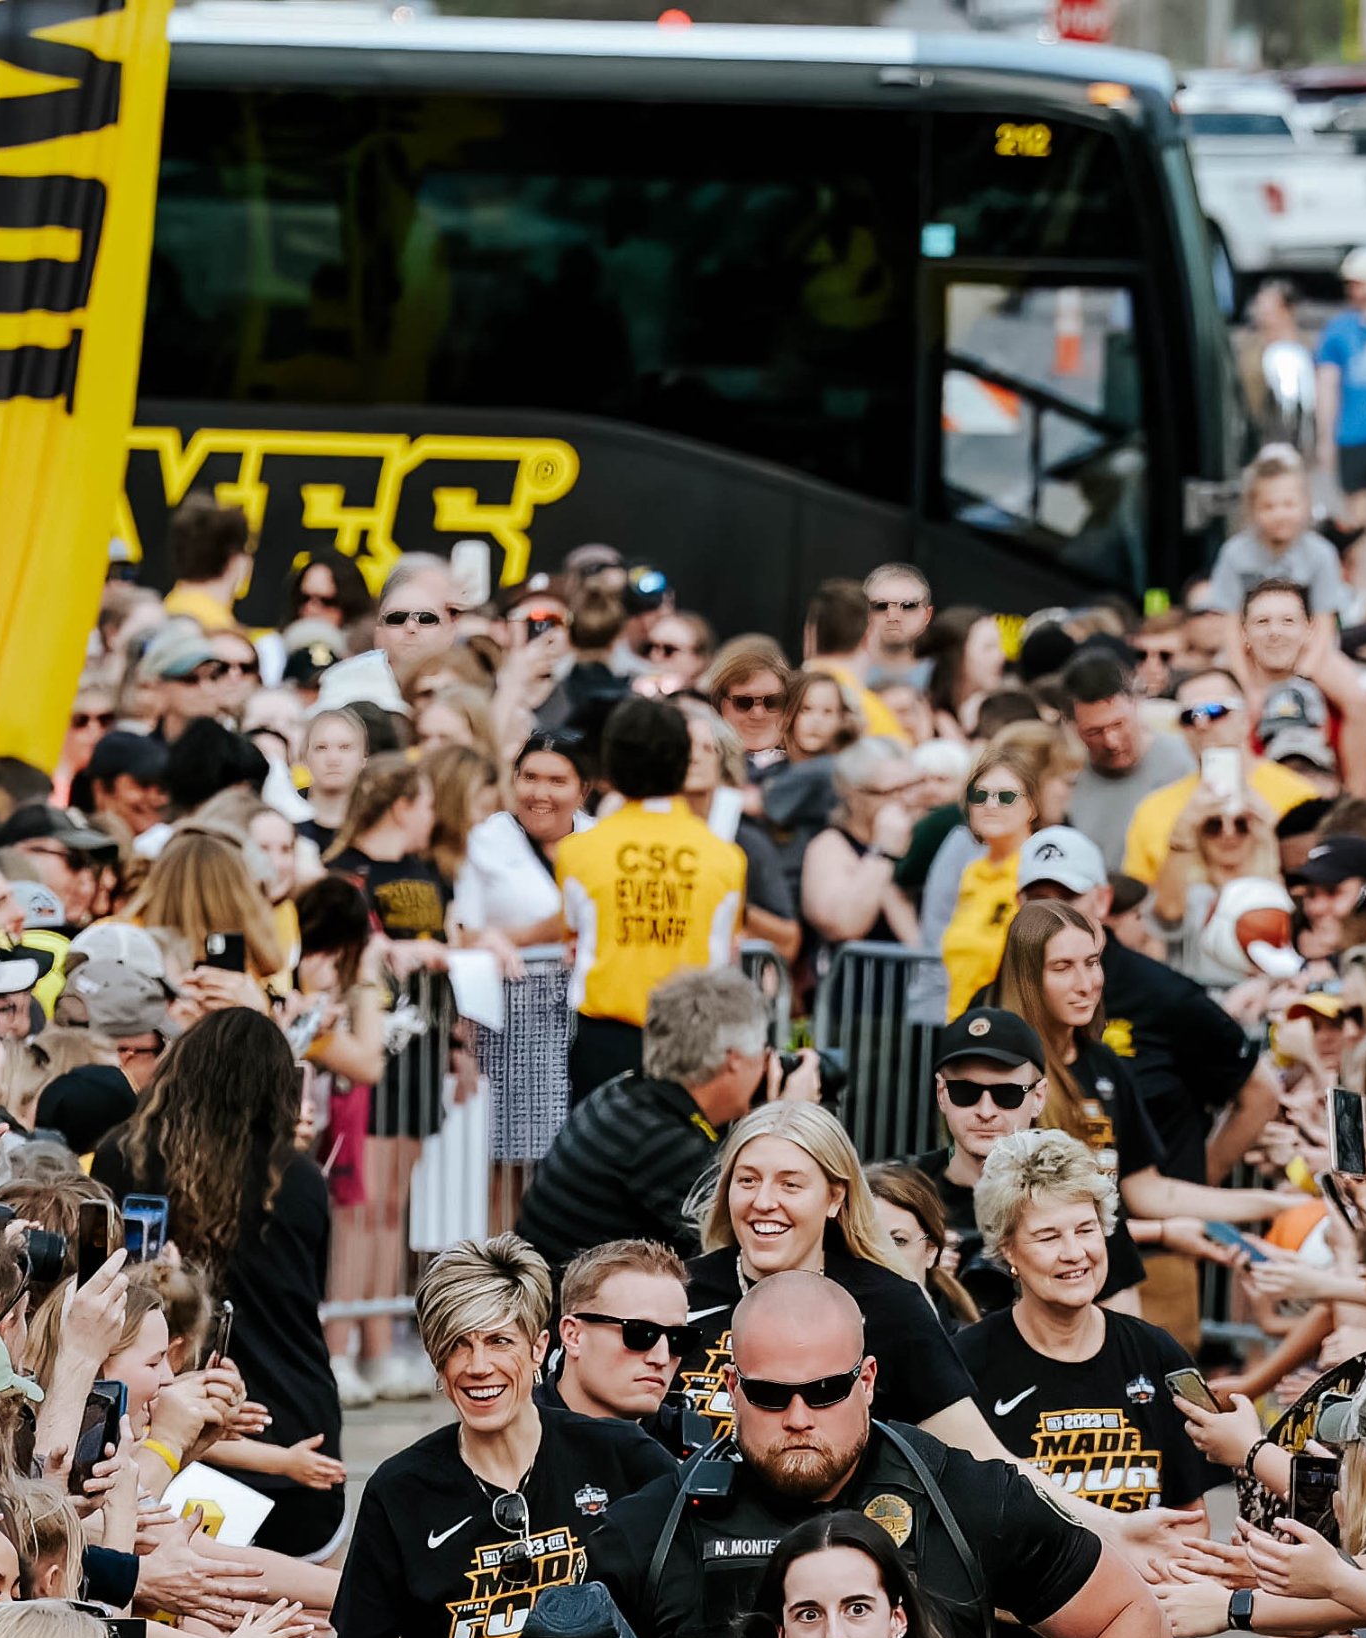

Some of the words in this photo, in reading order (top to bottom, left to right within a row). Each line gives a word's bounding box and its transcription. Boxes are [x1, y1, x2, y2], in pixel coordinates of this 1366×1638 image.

[616, 842, 698, 877] CSC
[615, 879, 694, 913] EVENT
[615, 915, 688, 948] STAFF
[1041, 1431, 1139, 1457] MADE
[1049, 1454, 1159, 1493] OUR
[714, 1540, 728, 1556] N.
[731, 1538, 782, 1556] MONTE
